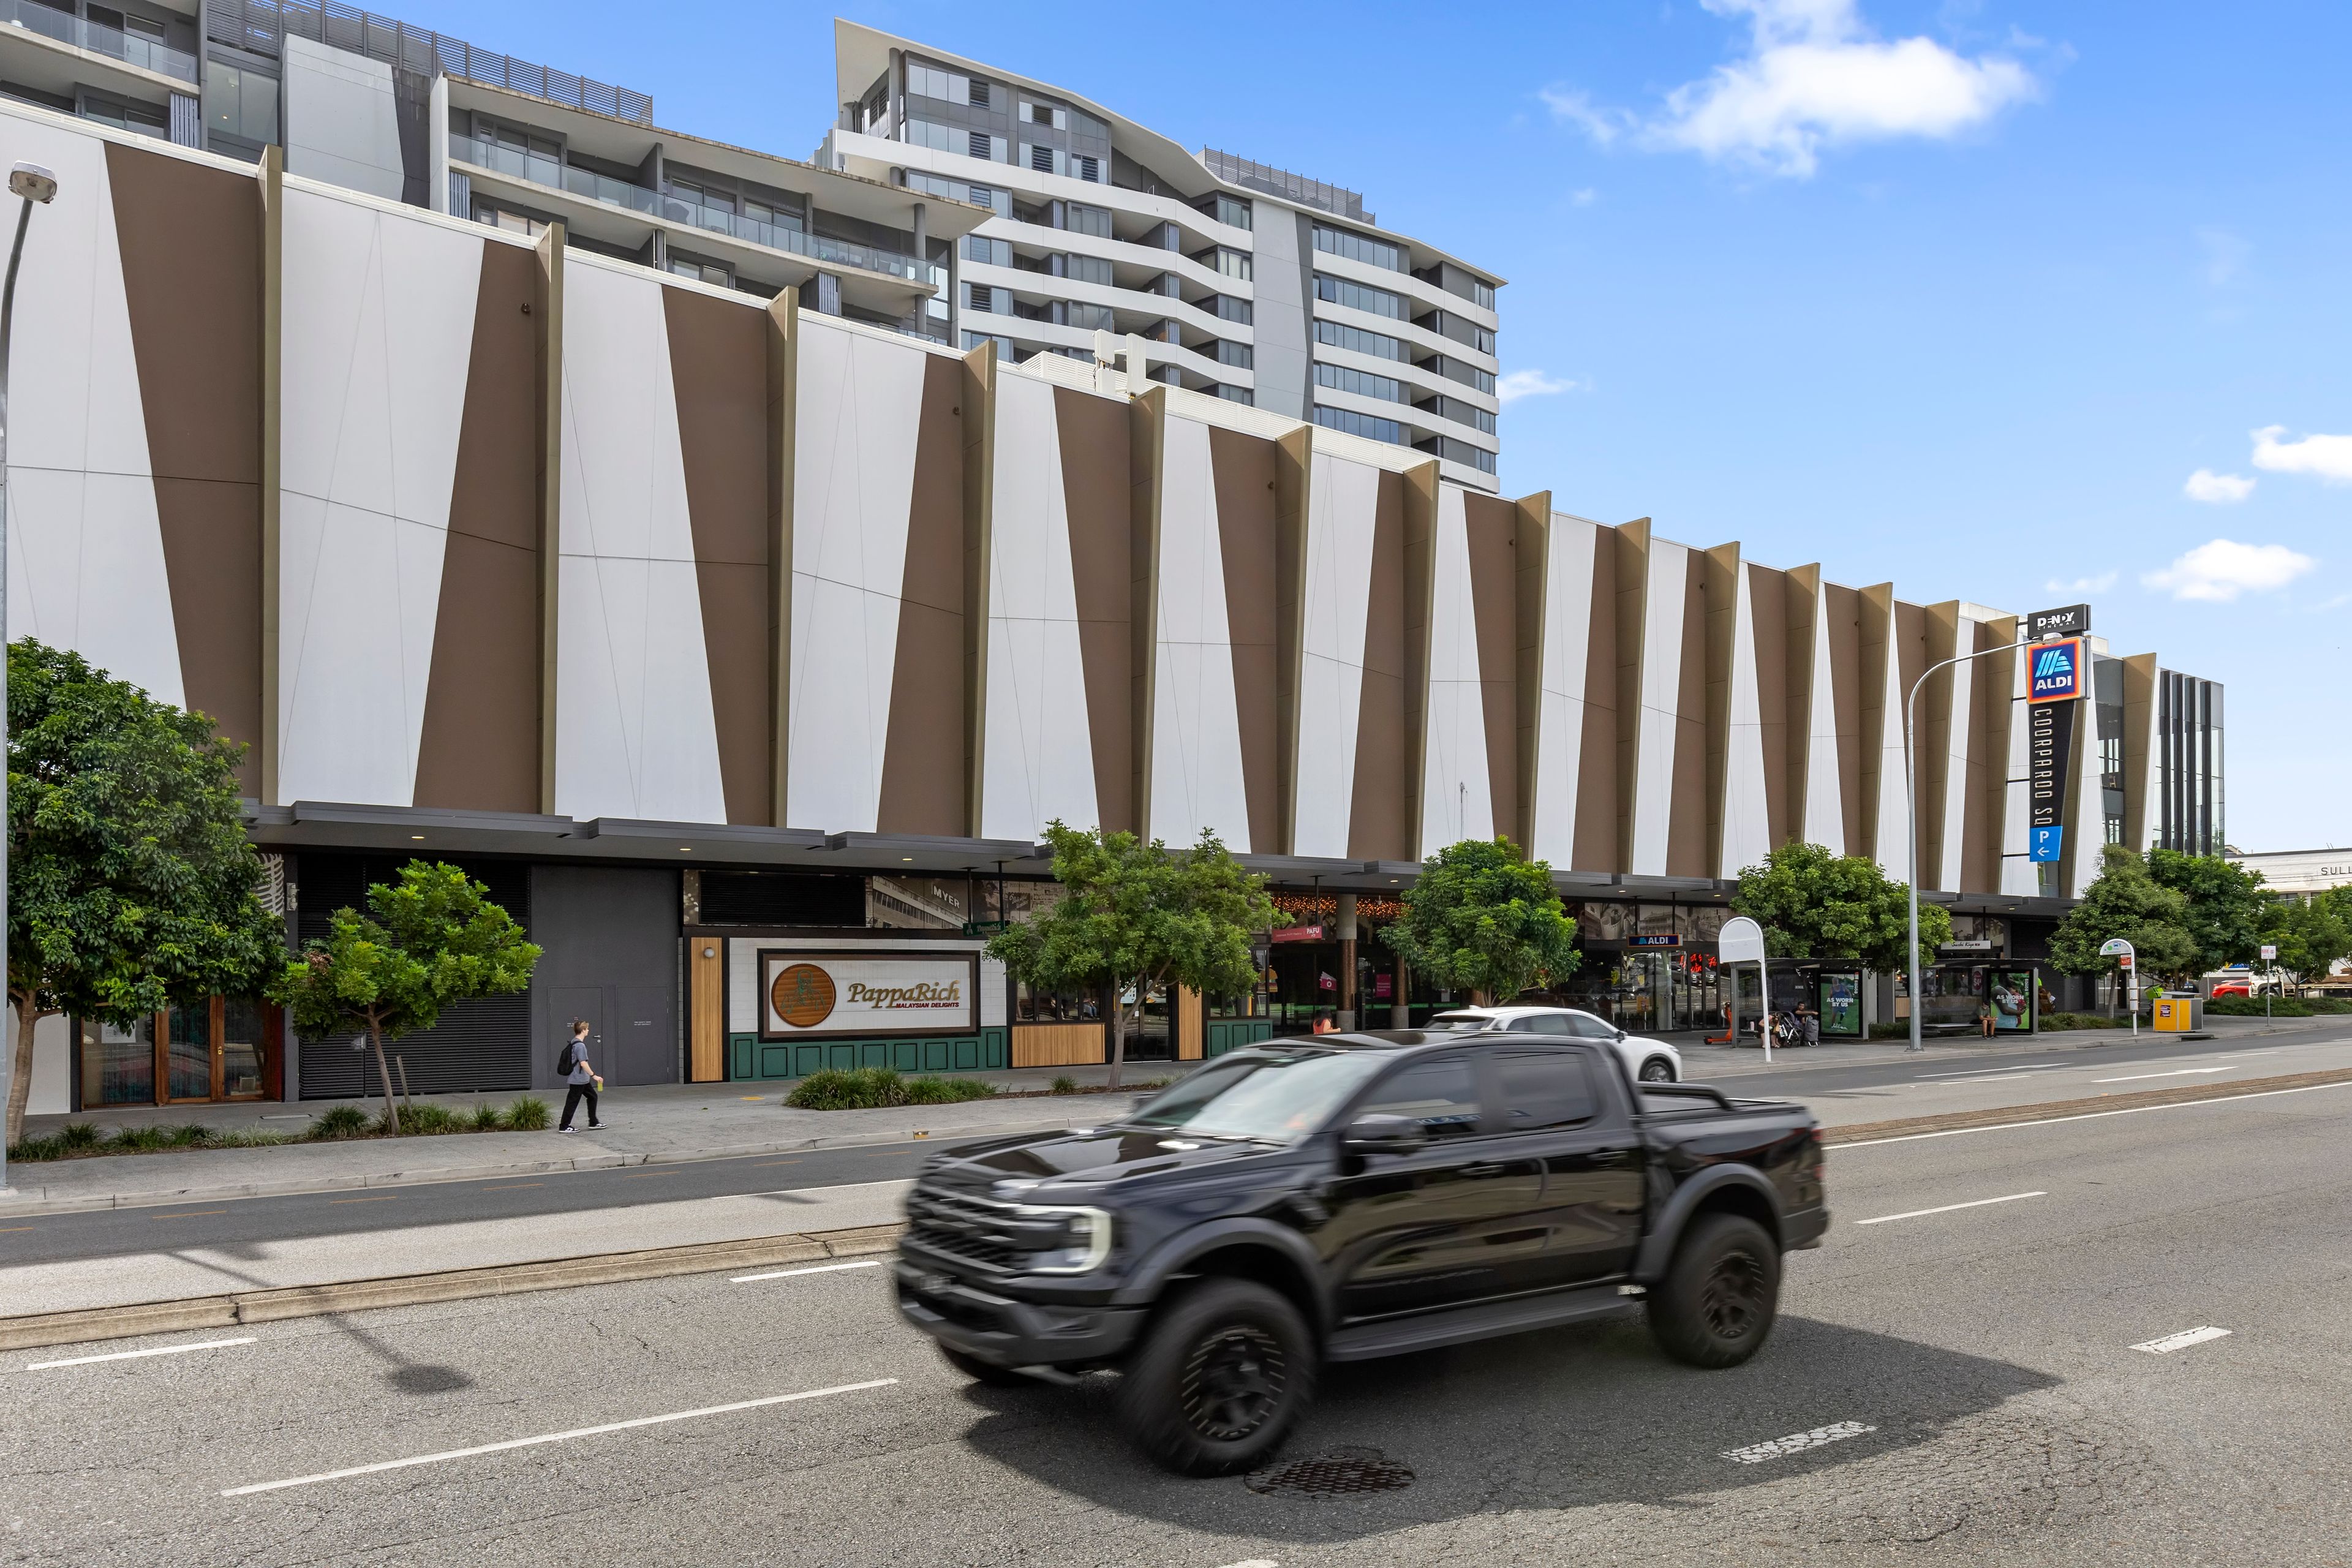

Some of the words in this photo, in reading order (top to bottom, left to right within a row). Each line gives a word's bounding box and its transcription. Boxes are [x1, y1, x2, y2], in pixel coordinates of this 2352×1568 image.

[2037, 612, 2075, 627] DENDY
[2037, 620, 2075, 630] CINEMAS
[2035, 675, 2072, 691] ALDI
[2034, 708, 2052, 799] COORPAROO
[2034, 807, 2052, 826] SQ
[2039, 831, 2049, 843] P
[2321, 866, 2352, 875] SULL
[933, 886, 960, 909] MYER
[847, 980, 960, 1009] PappaRich
